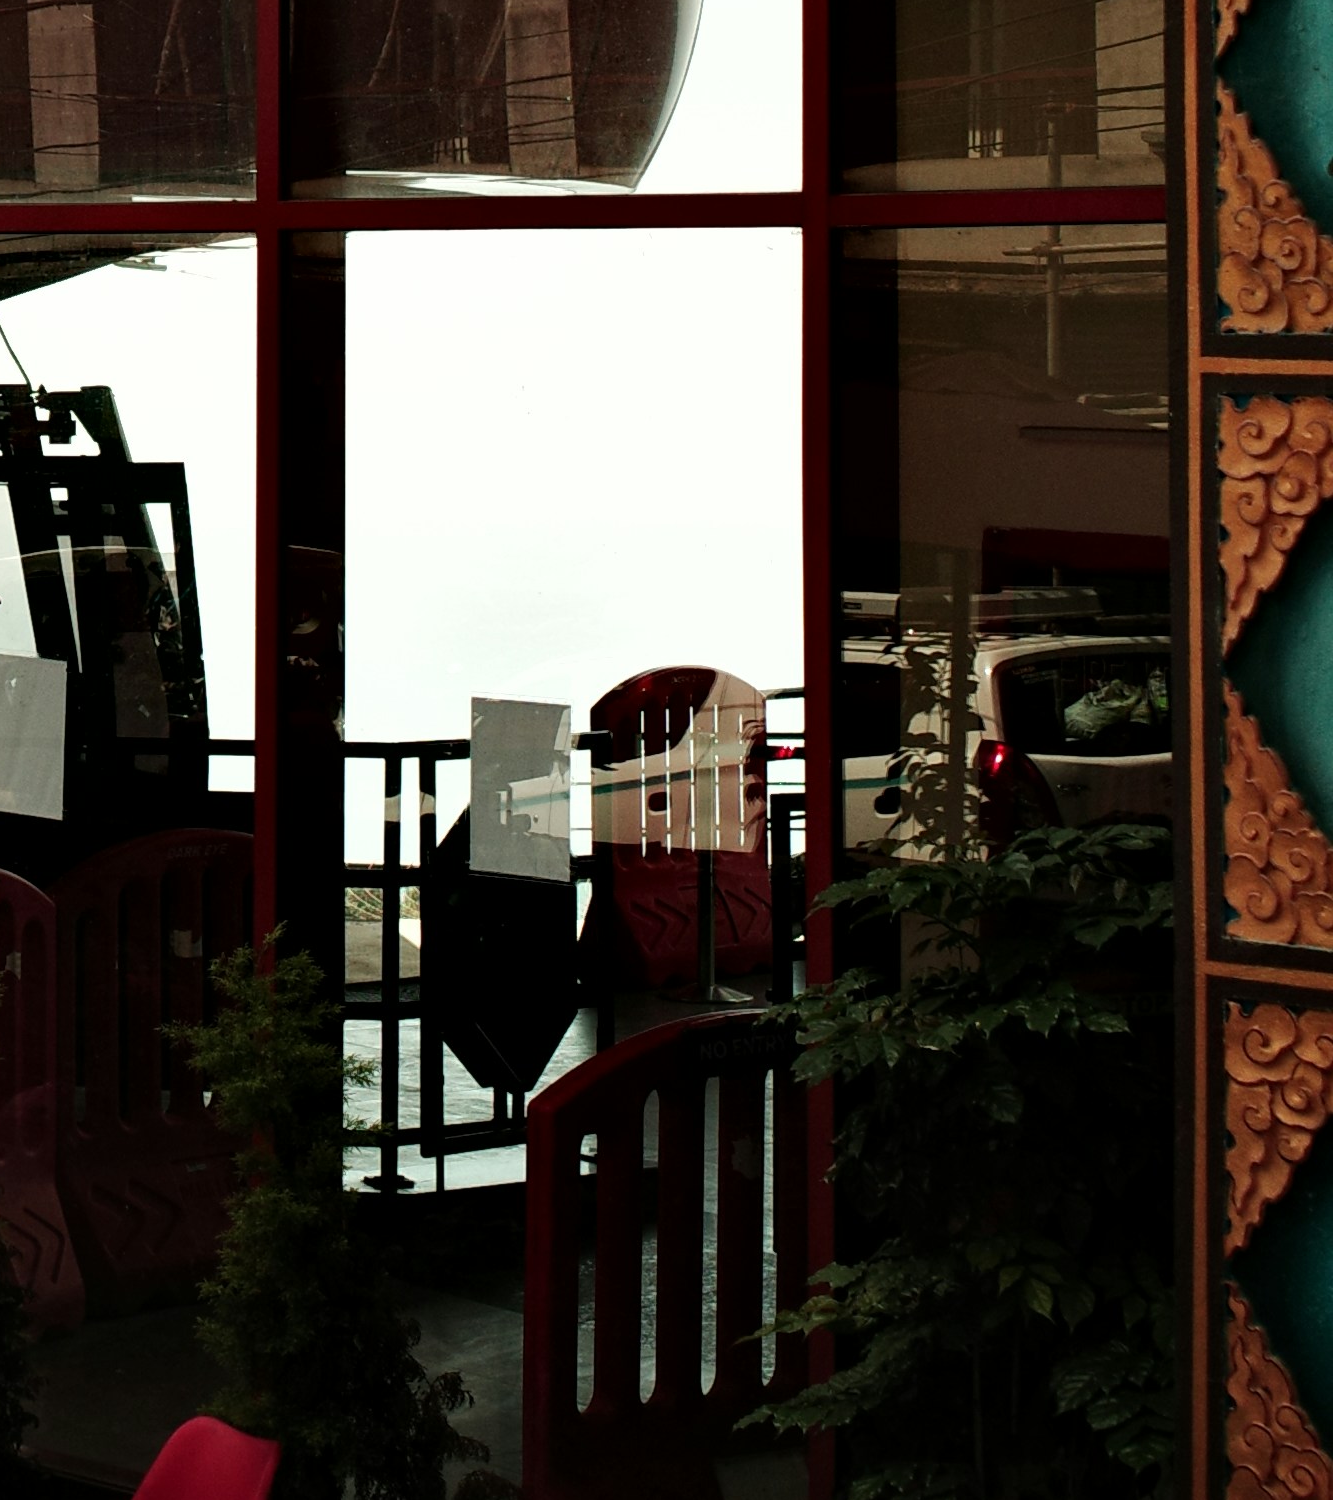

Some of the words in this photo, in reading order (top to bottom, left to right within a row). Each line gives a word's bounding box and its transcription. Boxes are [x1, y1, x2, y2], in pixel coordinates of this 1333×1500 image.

[204, 842, 230, 857] EYE
[699, 1039, 728, 1061] NO
[731, 1032, 789, 1057] ENTRY
